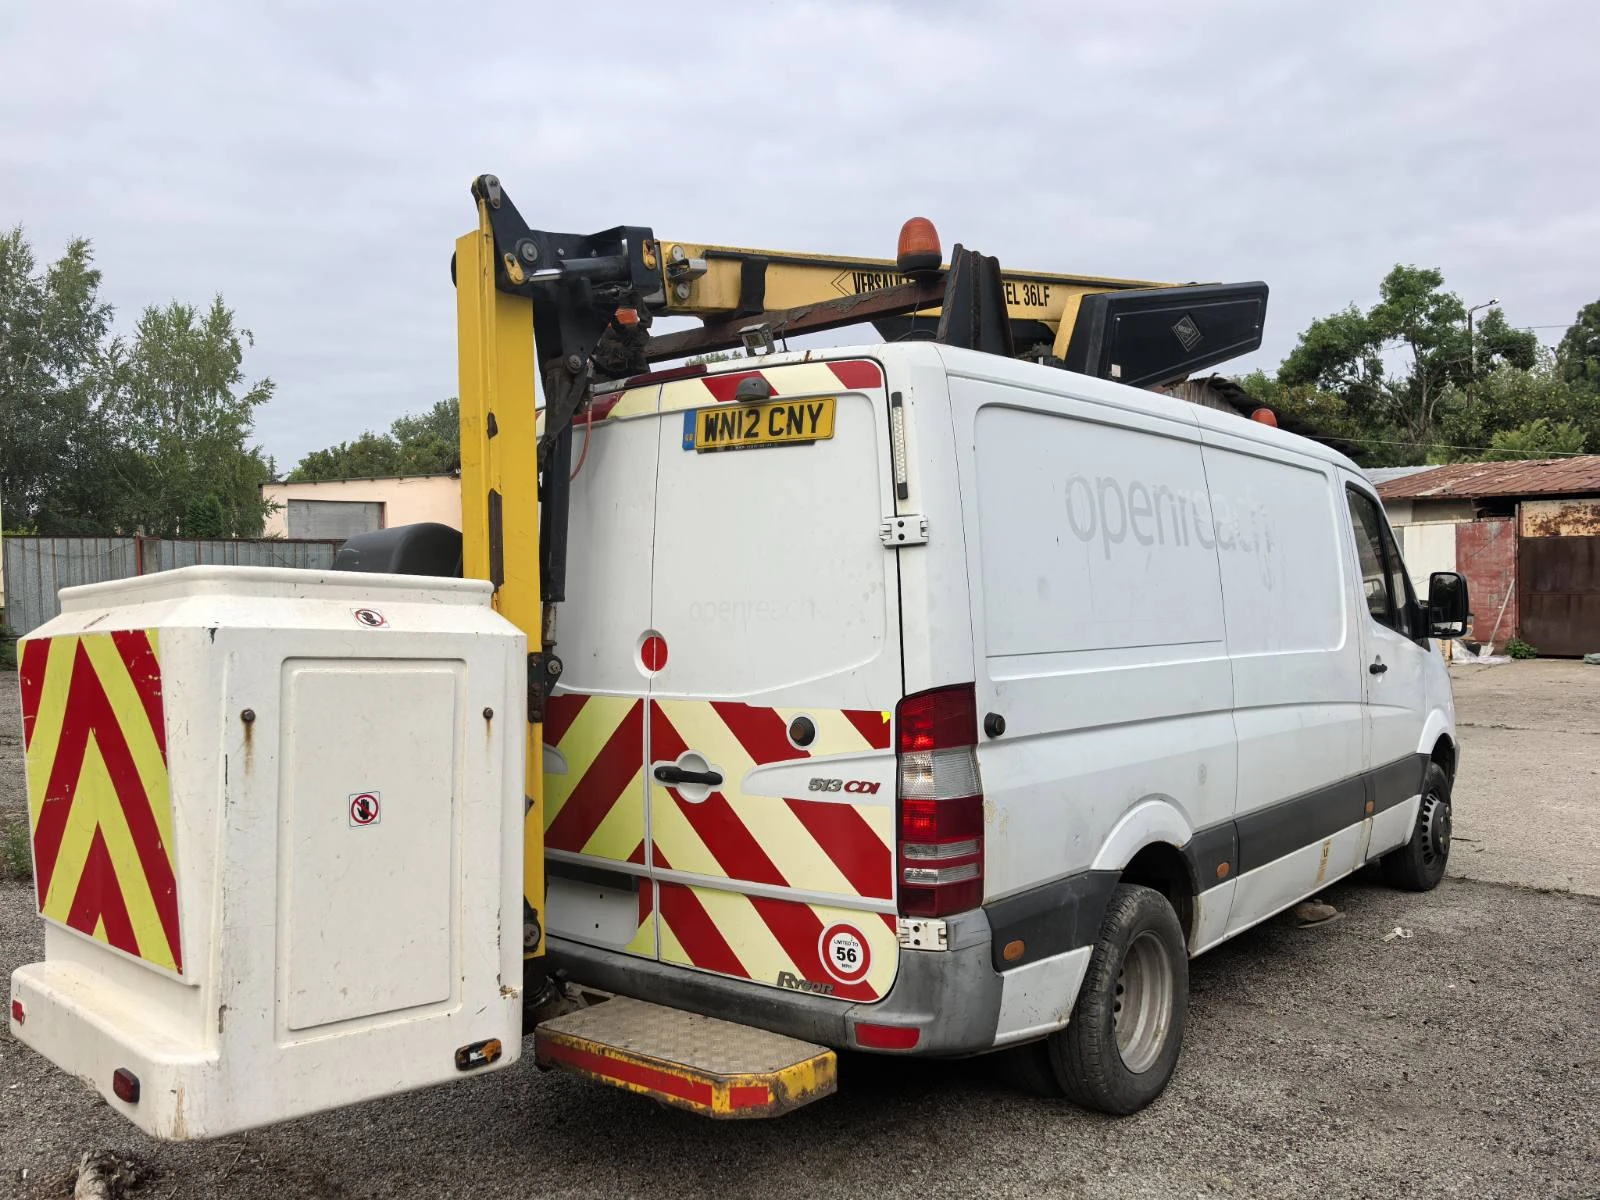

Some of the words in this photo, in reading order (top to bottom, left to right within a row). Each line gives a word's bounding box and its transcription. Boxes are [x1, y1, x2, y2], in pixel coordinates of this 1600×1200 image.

[852, 271, 911, 293] VERSALI
[1001, 281, 1020, 305] EL
[1023, 284, 1050, 307] 36LF
[704, 410, 761, 442] WN12
[768, 403, 824, 436] CNY
[808, 778, 843, 792] 513
[844, 780, 881, 795] CDI
[836, 947, 857, 963] 56
